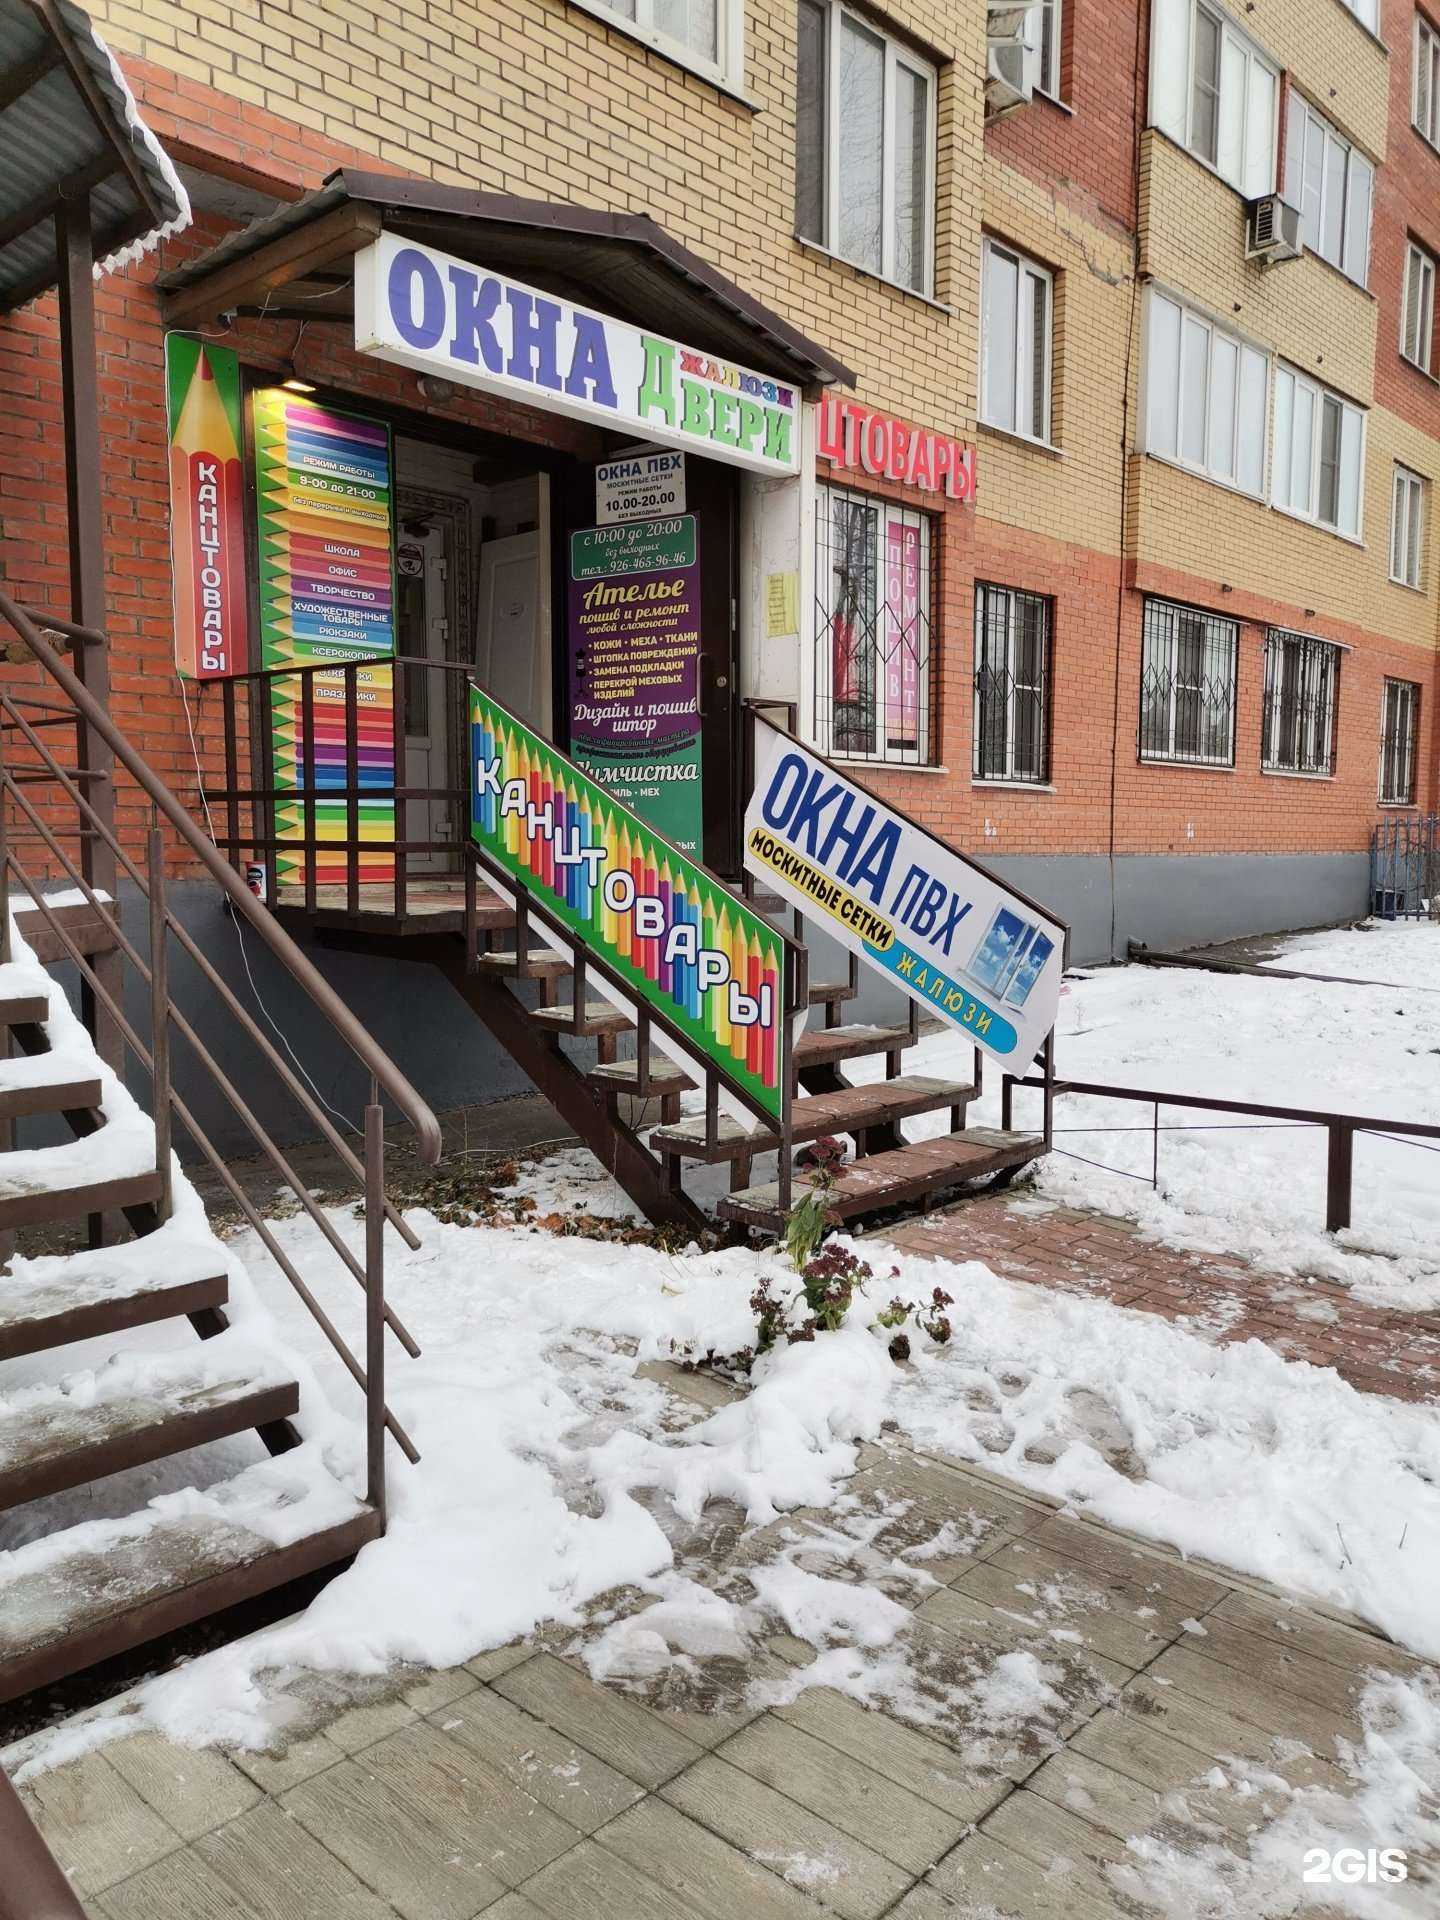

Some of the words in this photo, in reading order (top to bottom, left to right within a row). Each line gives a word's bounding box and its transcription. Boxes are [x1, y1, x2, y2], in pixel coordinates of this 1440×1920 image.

[388, 247, 618, 409] ОКНА
[680, 350, 793, 408] ЖАЛЮЗИ
[638, 335, 792, 464] ДВЕРИ
[303, 456, 337, 471] РЕЖИМ
[339, 464, 375, 479] РАБОТЫ
[598, 462, 642, 481] ОКНА
[647, 455, 682, 473] ПВХ
[299, 475, 328, 489] 9-00
[330, 484, 344, 494] до
[346, 487, 376, 500] 21-00
[607, 477, 650, 489] МОСКИТНЫЕ
[651, 473, 673, 482] СЕТКИ
[606, 492, 675, 512] 10.00-20.00
[584, 536, 591, 546] с
[594, 528, 625, 545] 10:00
[628, 529, 643, 545] до
[646, 520, 682, 537] 20:00
[324, 544, 360, 558] ШКОЛА
[610, 551, 686, 572] 926-465-96-46
[198, 462, 226, 671] КАНЦТОВАРЫ
[328, 565, 357, 578] ОФИС
[310, 584, 375, 600] ТВОРЧЕСТВО
[582, 579, 686, 610] Ателье
[294, 602, 388, 623] ХУДОЖЕСТВЕННЫЕ
[322, 614, 363, 627] ТОВАРЫ
[579, 608, 621, 624] пошив
[624, 611, 634, 620] и
[635, 602, 690, 623] ремонт
[319, 626, 368, 640] РЮКЗАКИ
[586, 622, 617, 635] любой
[620, 617, 678, 631] сложности
[594, 638, 622, 650] КОЖИ
[630, 635, 657, 646] МЕХА
[665, 631, 698, 643] ТКАНИ
[312, 647, 377, 661] КСЕРОКОПИЯ
[593, 654, 629, 664] ШТОПКА
[630, 645, 697, 661] ПОВРЕЖДЕНИЙ
[593, 665, 628, 676] ЗАМЕНА
[629, 661, 684, 674] ПОДКЛАДКИ
[593, 678, 637, 689] ПЕРЕКРОЙ
[638, 674, 682, 686] МЕХОВЫХ
[593, 687, 634, 699] ИЗДЕЛИЙ
[574, 702, 630, 726] Дизайн
[634, 705, 644, 716] и
[648, 697, 697, 715] пошив
[612, 718, 657, 737] штор
[640, 788, 660, 797] МЕХ
[762, 753, 903, 907] ОКНА
[890, 863, 974, 956] ПВХ
[476, 757, 774, 1028] КАНЦТОВАРЫ
[750, 829, 841, 912] МОСКИТНЫЕ
[840, 898, 893, 949] СЕТКИ
[896, 951, 993, 1036] ЖАЛЮЗИ
